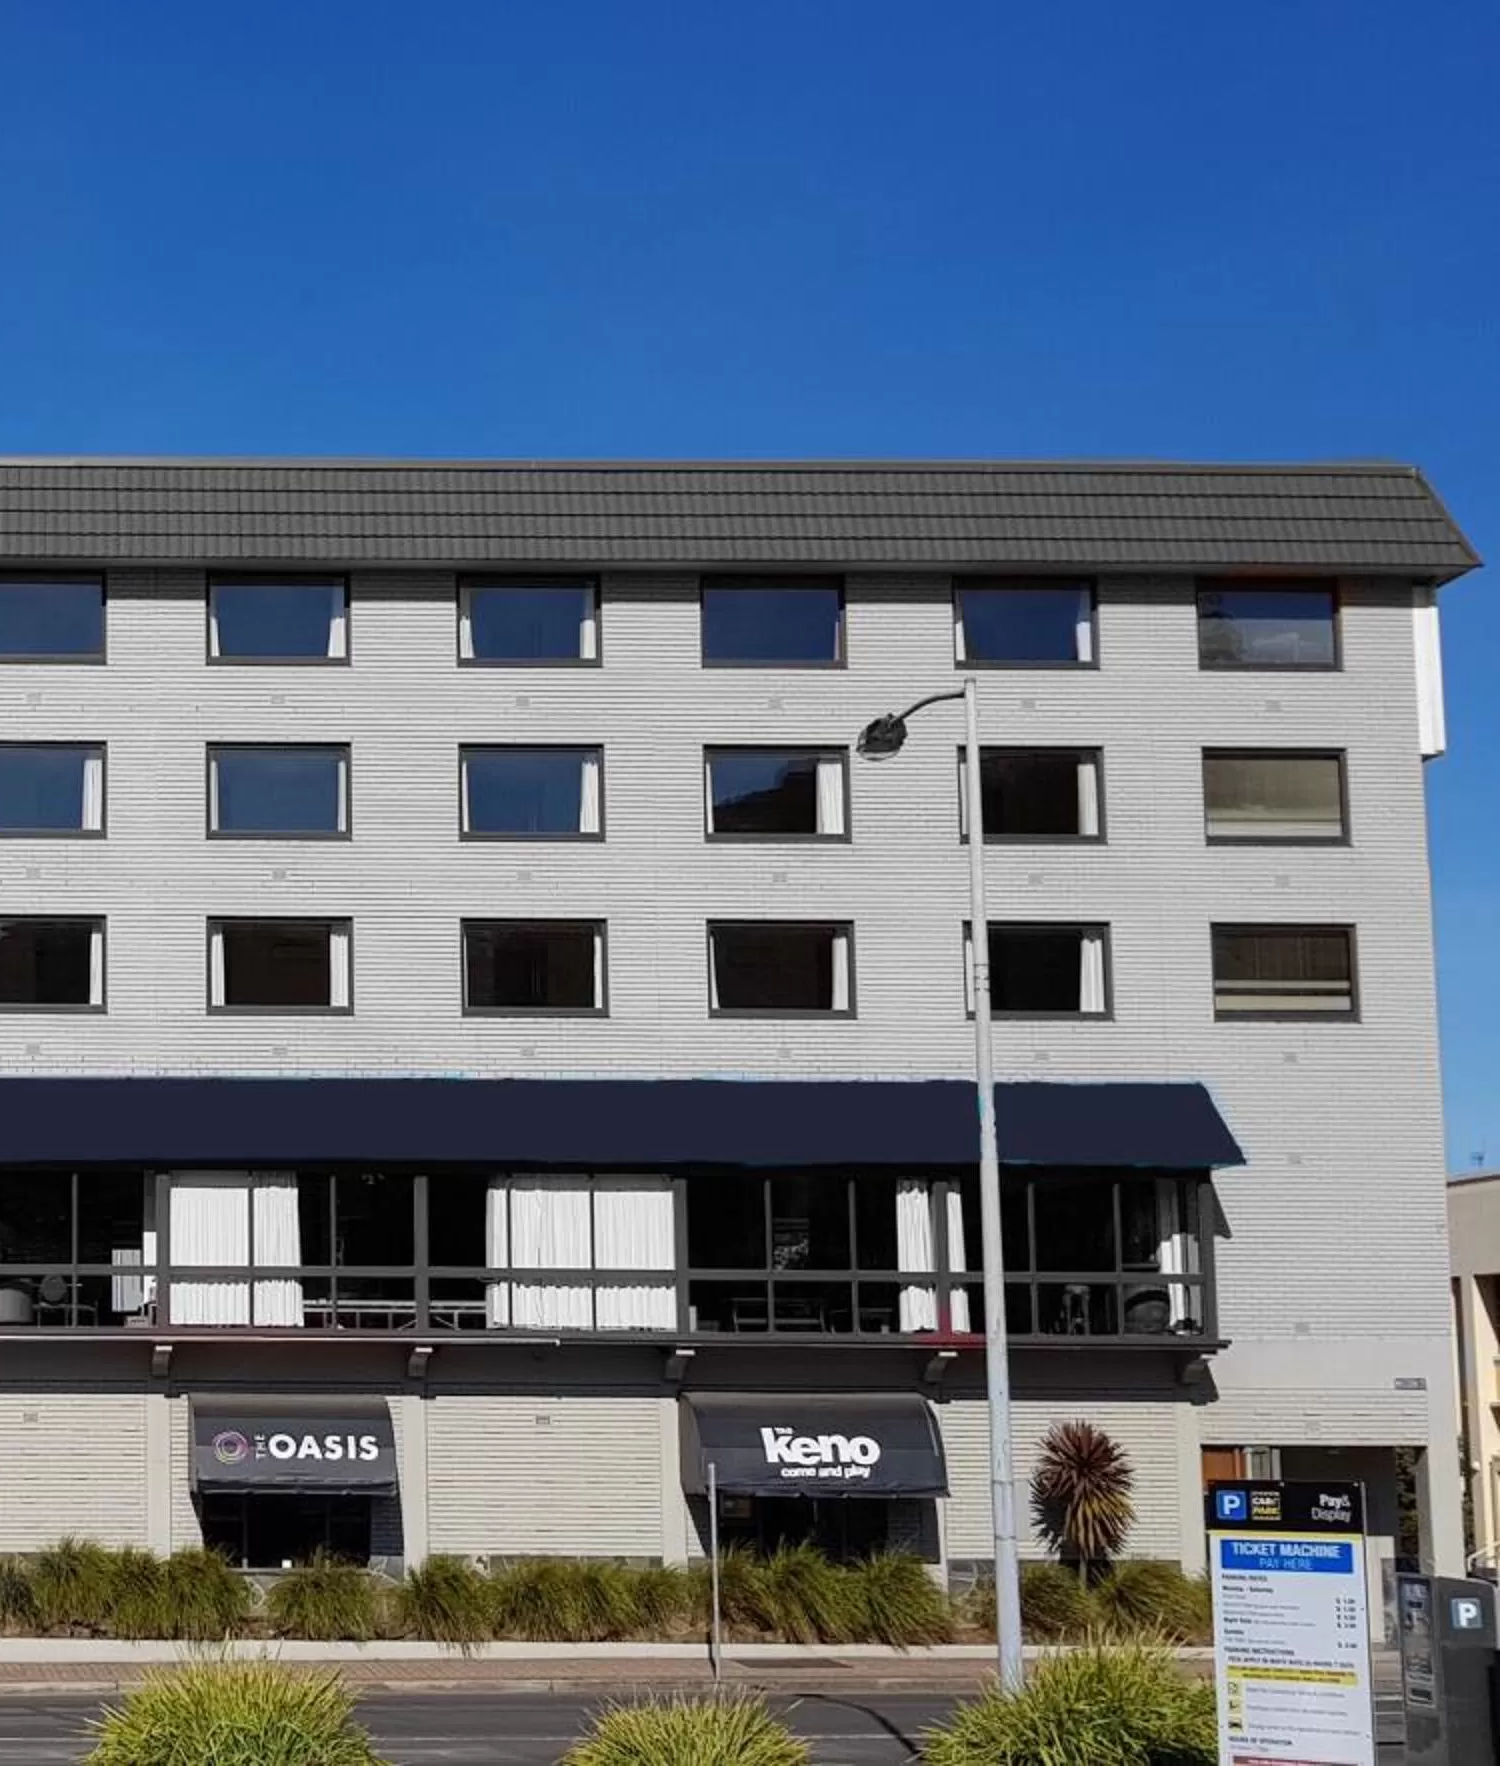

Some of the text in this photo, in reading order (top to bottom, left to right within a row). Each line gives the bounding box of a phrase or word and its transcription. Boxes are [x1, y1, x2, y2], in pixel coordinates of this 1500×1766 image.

[255, 1434, 379, 1461] THE OASIS
[760, 1427, 880, 1465] keno
[781, 1464, 871, 1479] come and play
[1223, 1495, 1240, 1515] P
[1311, 1507, 1351, 1523] Display
[1231, 1541, 1341, 1559] TICKET MACHINE
[1260, 1558, 1312, 1570] PAY HERE
[1458, 1603, 1477, 1627] P
